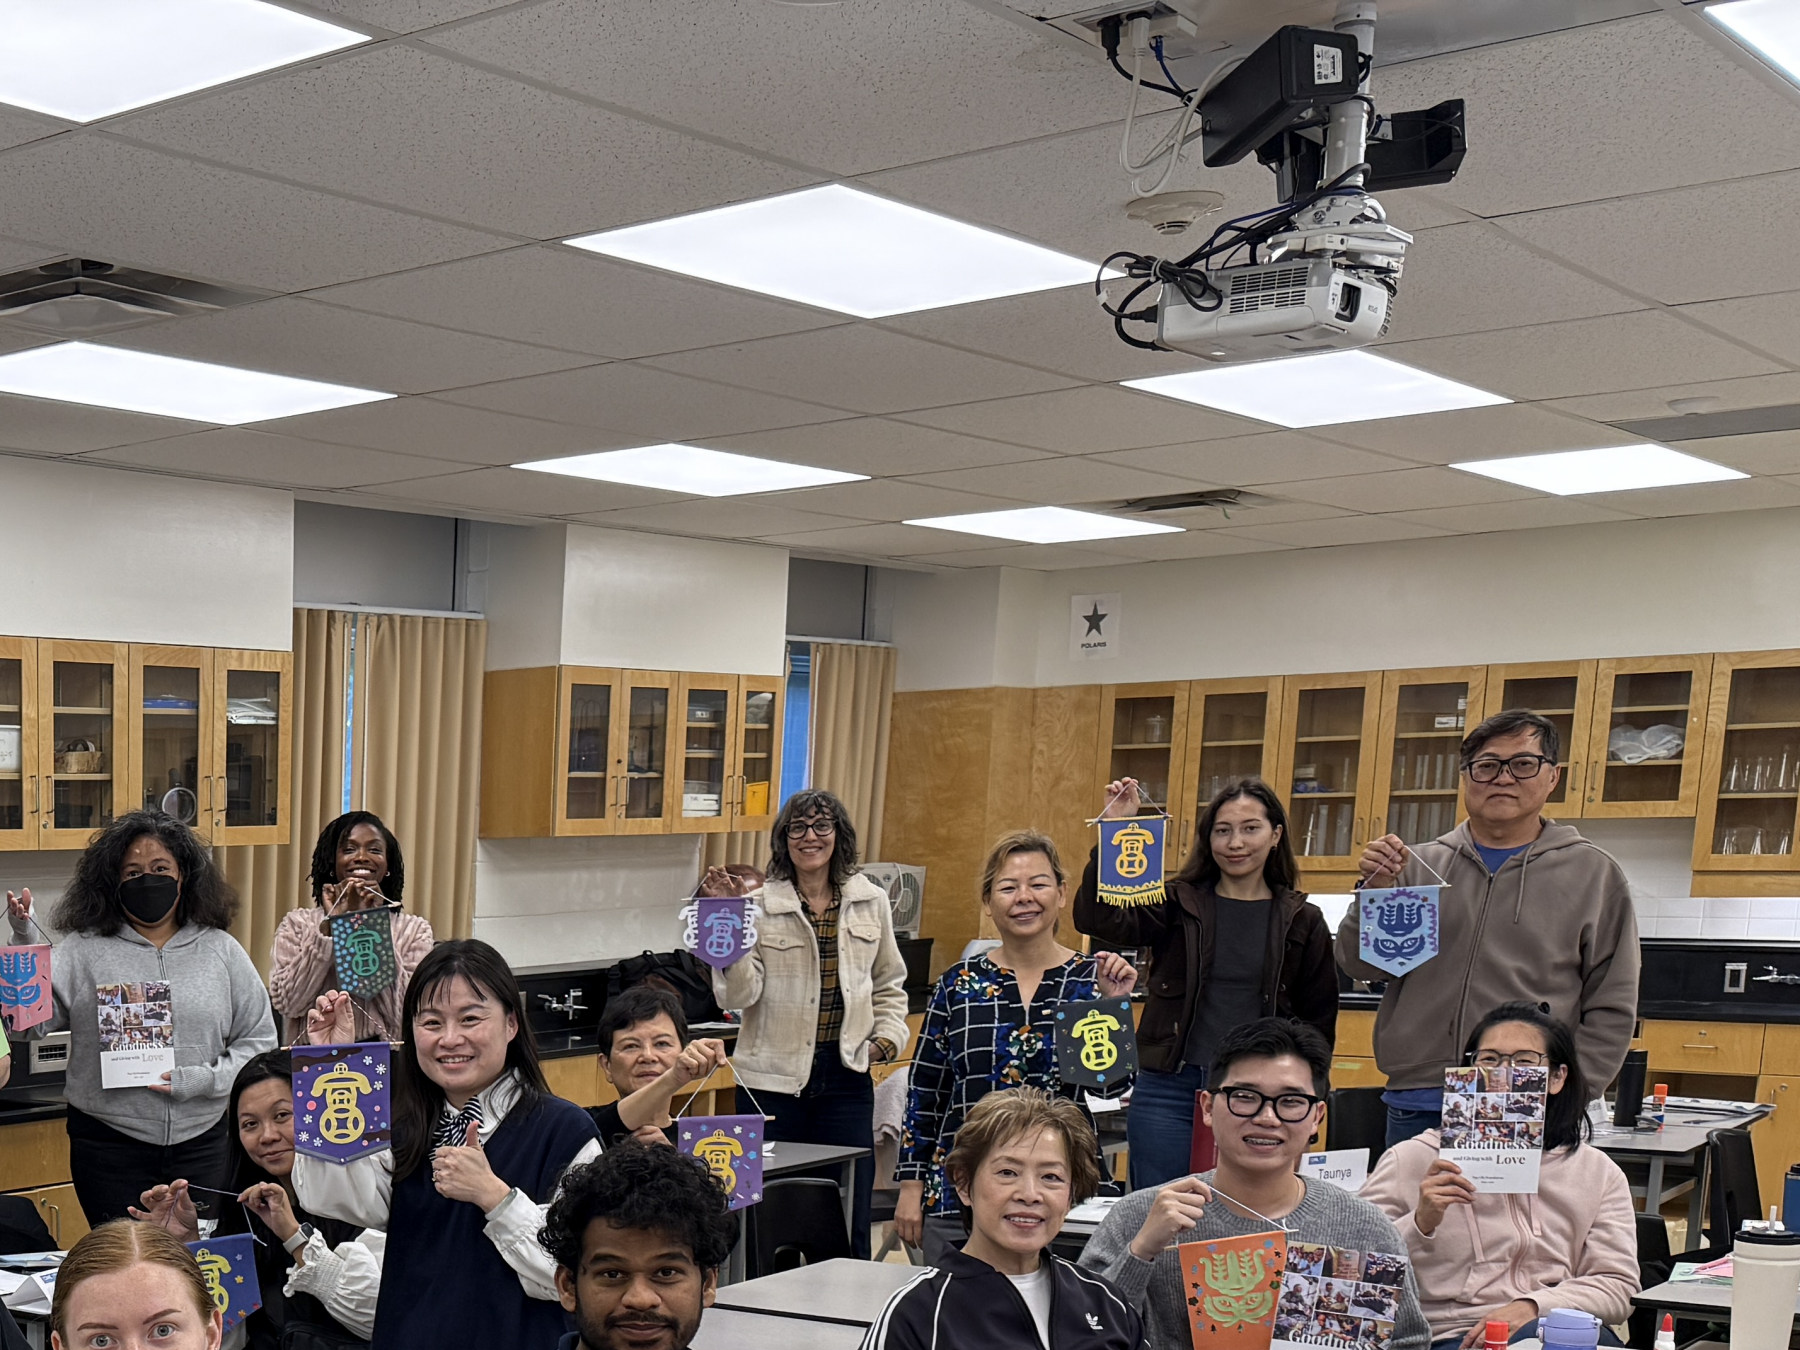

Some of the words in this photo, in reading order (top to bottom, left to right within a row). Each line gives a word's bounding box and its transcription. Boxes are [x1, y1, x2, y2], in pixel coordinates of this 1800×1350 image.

[1080, 641, 1107, 649] POLARIS
[110, 1039, 164, 1052] Goodness
[142, 1053, 164, 1062] Love
[1453, 1137, 1528, 1150] Goodness
[1496, 1154, 1526, 1165] Love
[1318, 1168, 1352, 1180] Taunya
